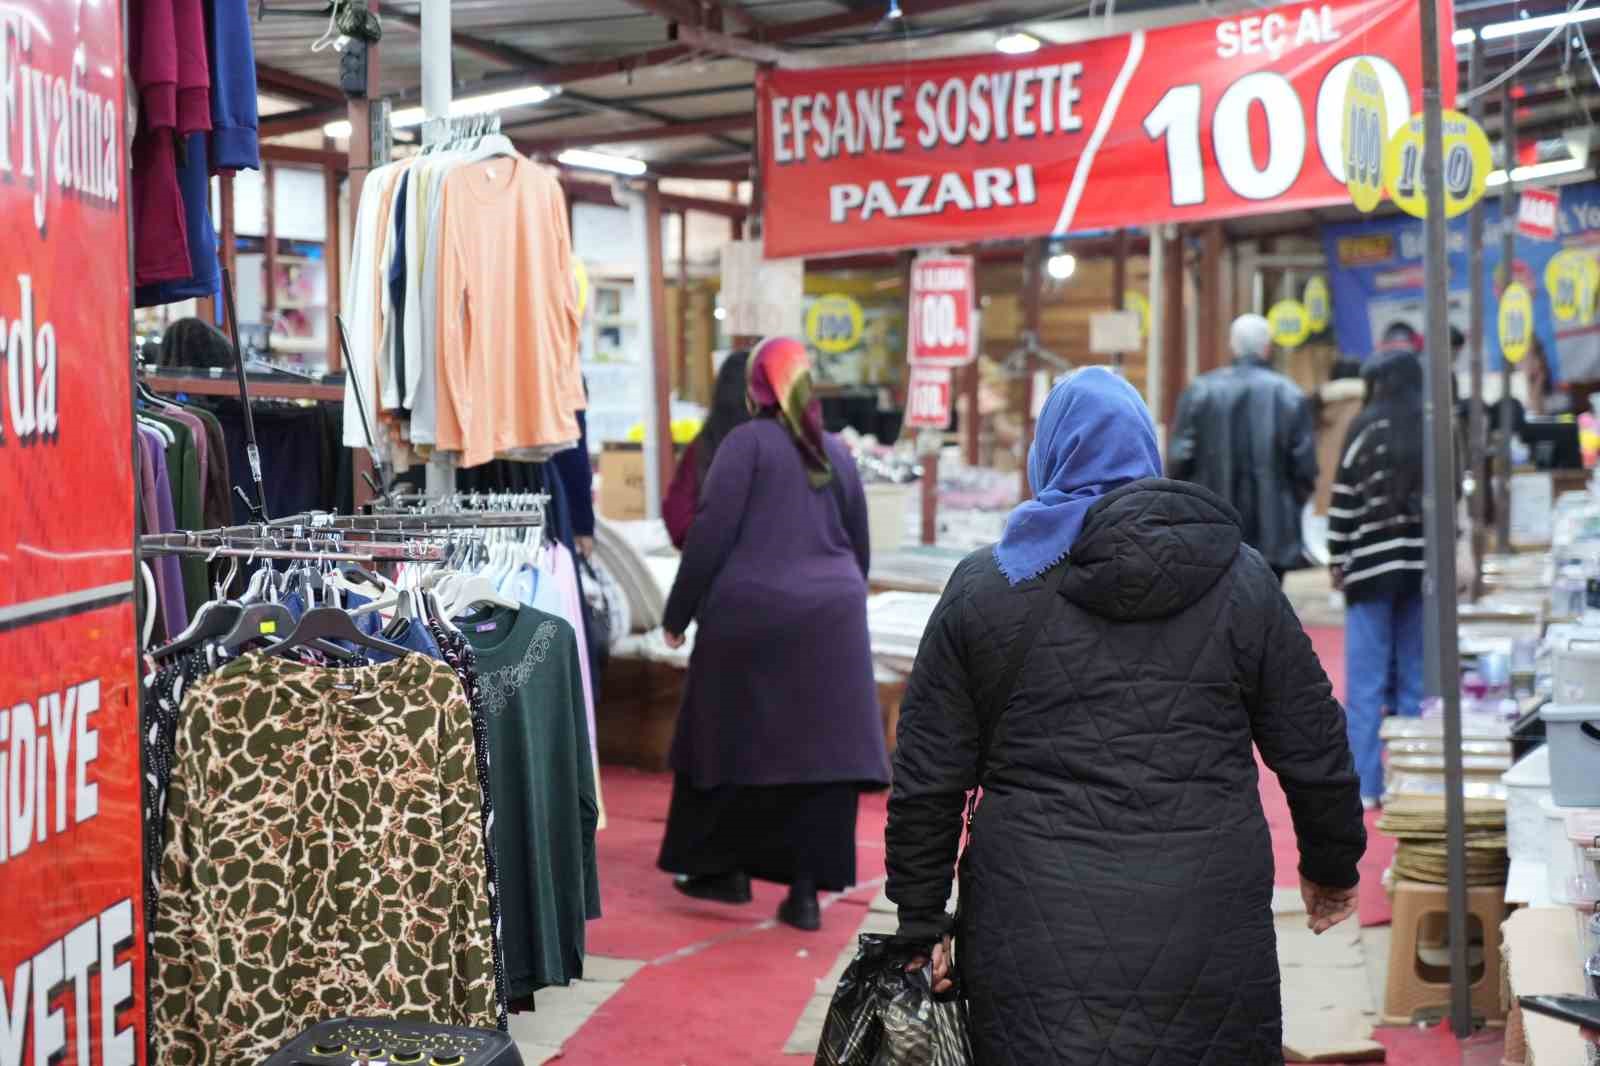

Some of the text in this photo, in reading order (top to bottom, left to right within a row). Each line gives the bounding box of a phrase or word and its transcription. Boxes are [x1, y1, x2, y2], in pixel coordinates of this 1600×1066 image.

[1216, 4, 1341, 61] SEÇ AL
[771, 61, 1083, 163] EFSANE SOSYETE
[1143, 55, 1411, 207] 100
[829, 163, 1036, 223] PAZARI
[1398, 142, 1472, 200] 10
